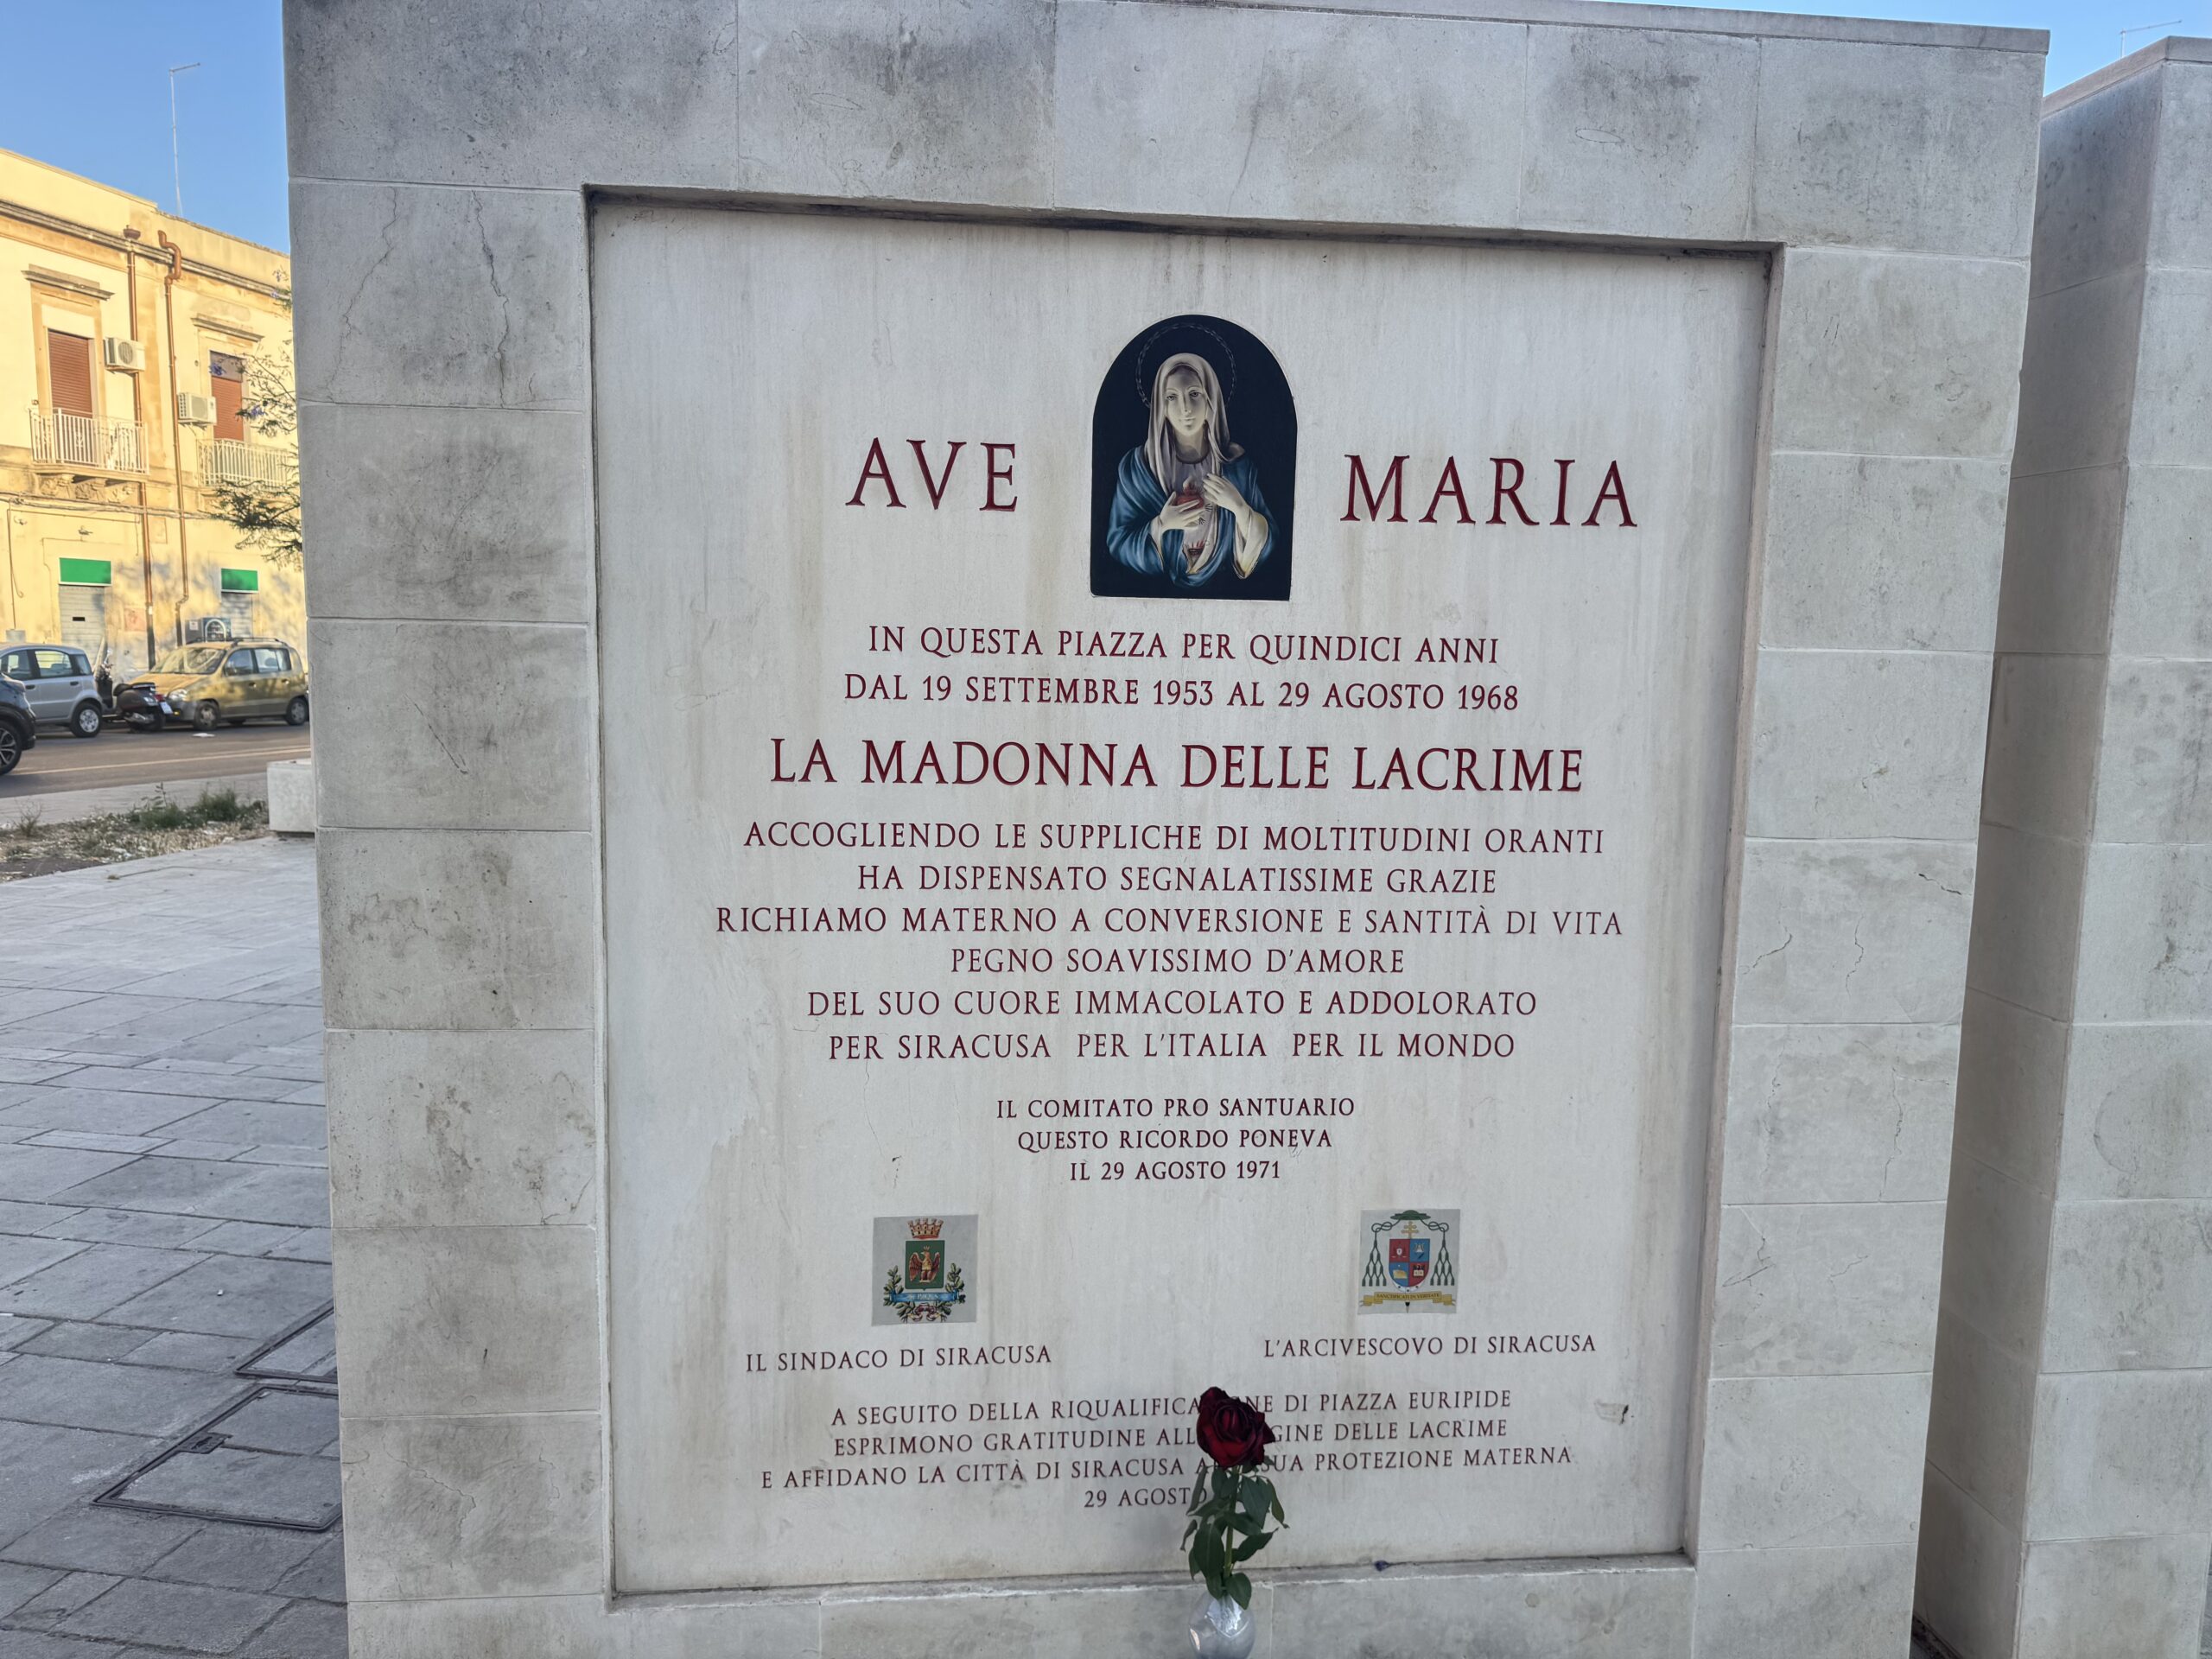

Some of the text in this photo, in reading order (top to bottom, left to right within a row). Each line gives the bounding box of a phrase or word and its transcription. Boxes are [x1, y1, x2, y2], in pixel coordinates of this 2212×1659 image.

[845, 437, 1637, 527] AVE MARIA
[869, 626, 1498, 664] IN QUESTA PIAZZA PER QUINDICI ANNI
[845, 674, 1517, 712] DAL 19 SETTEMBRE 1953 AL 29 AGOSTO 1968
[771, 739, 1582, 792] LA MADONNA DELLE LACRIME
[744, 822, 1604, 853] ACCOGLIENDO LE SUPPLICHE DI MOLTITUDINI ORANTI
[858, 866, 1495, 893] HA DISPENSATO SEGNALATISSIME GRAZIE
[716, 906, 1622, 935] RICHIAMO MATERNO A CONVERSIONE E SANTITÀ DI VITA
[951, 949, 1403, 973] PEGNO SOAVISSIMO D'AMORE
[808, 990, 1535, 1016] DEL SUO CUORE IMMACOLATO E ADDOLORATO
[830, 1033, 1514, 1059] PER SIRACUSA PER L'ITALIA PER IL MONDO
[997, 1098, 1354, 1118] IL COMITATO PRO SANTUARIO
[1018, 1129, 1332, 1153] QUESTO RICORDO PONEVA
[1071, 1160, 1280, 1180] IL 29 AGOSTO 1971
[747, 1345, 1051, 1371] IL SINDACO DI SIRACUSA
[1265, 1335, 1595, 1357] L'ARCIVESCOVO DI SIRACUSA
[831, 1390, 1510, 1426] A SEGUITO DELLA RIQUALIFICANE DI PIAZZA EURIPIDE
[835, 1434, 972, 1456] ESPRIMONO
[984, 1429, 1145, 1451] GRATITUDINE
[1156, 1428, 1196, 1446] ALL
[1335, 1422, 1397, 1440] DELLE
[1409, 1420, 1506, 1439] LACRIME
[762, 1471, 772, 1488] E
[784, 1467, 906, 1488] AFFIDANO
[918, 1465, 945, 1484] LA
[957, 1461, 1027, 1482] CITTÀ
[1037, 1462, 1058, 1479] DI
[1071, 1459, 1183, 1478] SIRACUSA
[1316, 1450, 1452, 1471] PROTEZIONE
[1464, 1447, 1571, 1465] MATERNA
[1084, 1490, 1106, 1507] 29
